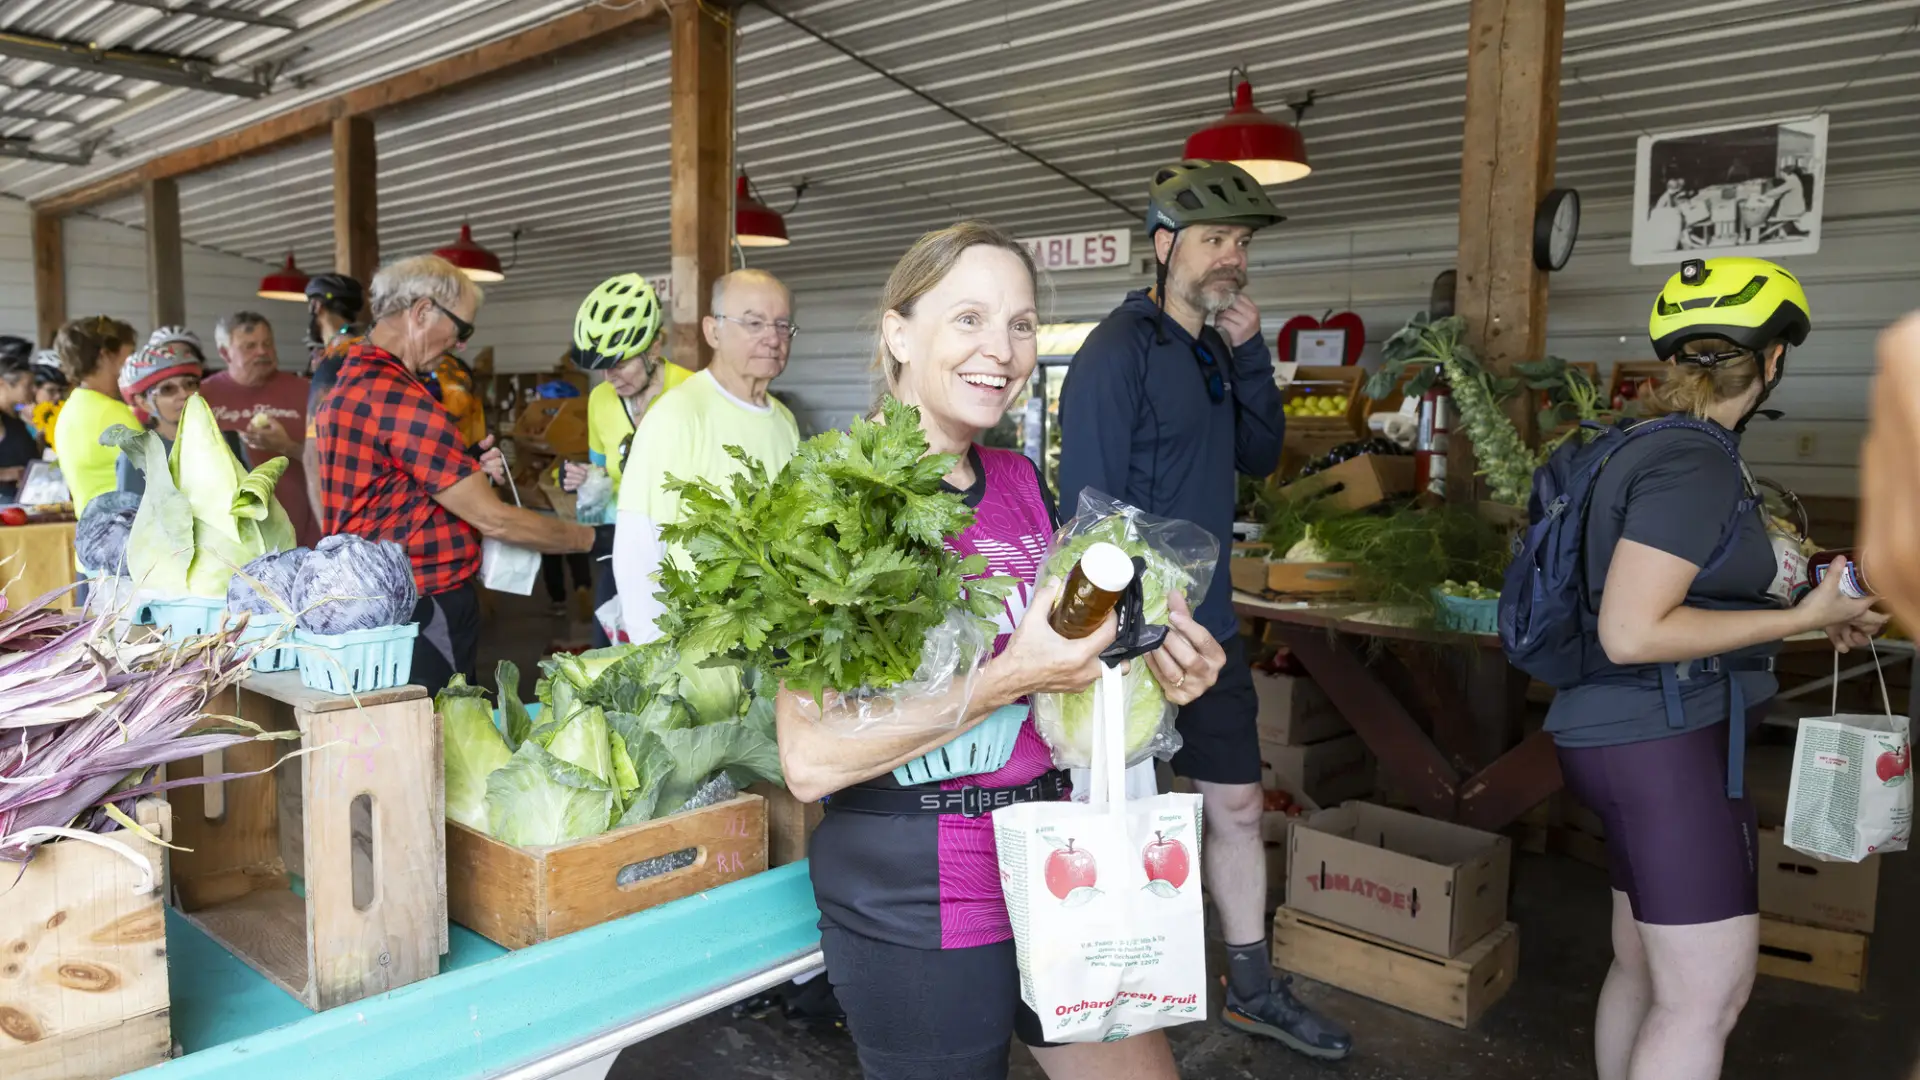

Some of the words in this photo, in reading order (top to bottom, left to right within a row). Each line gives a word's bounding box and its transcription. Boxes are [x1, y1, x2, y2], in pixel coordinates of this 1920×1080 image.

[1156, 210, 1175, 229] SMITH
[1306, 873, 1422, 913] TOMATOES
[1055, 998, 1115, 1016] Orchard
[1115, 991, 1157, 1002] Fresh
[1162, 993, 1198, 1004] Fruit
